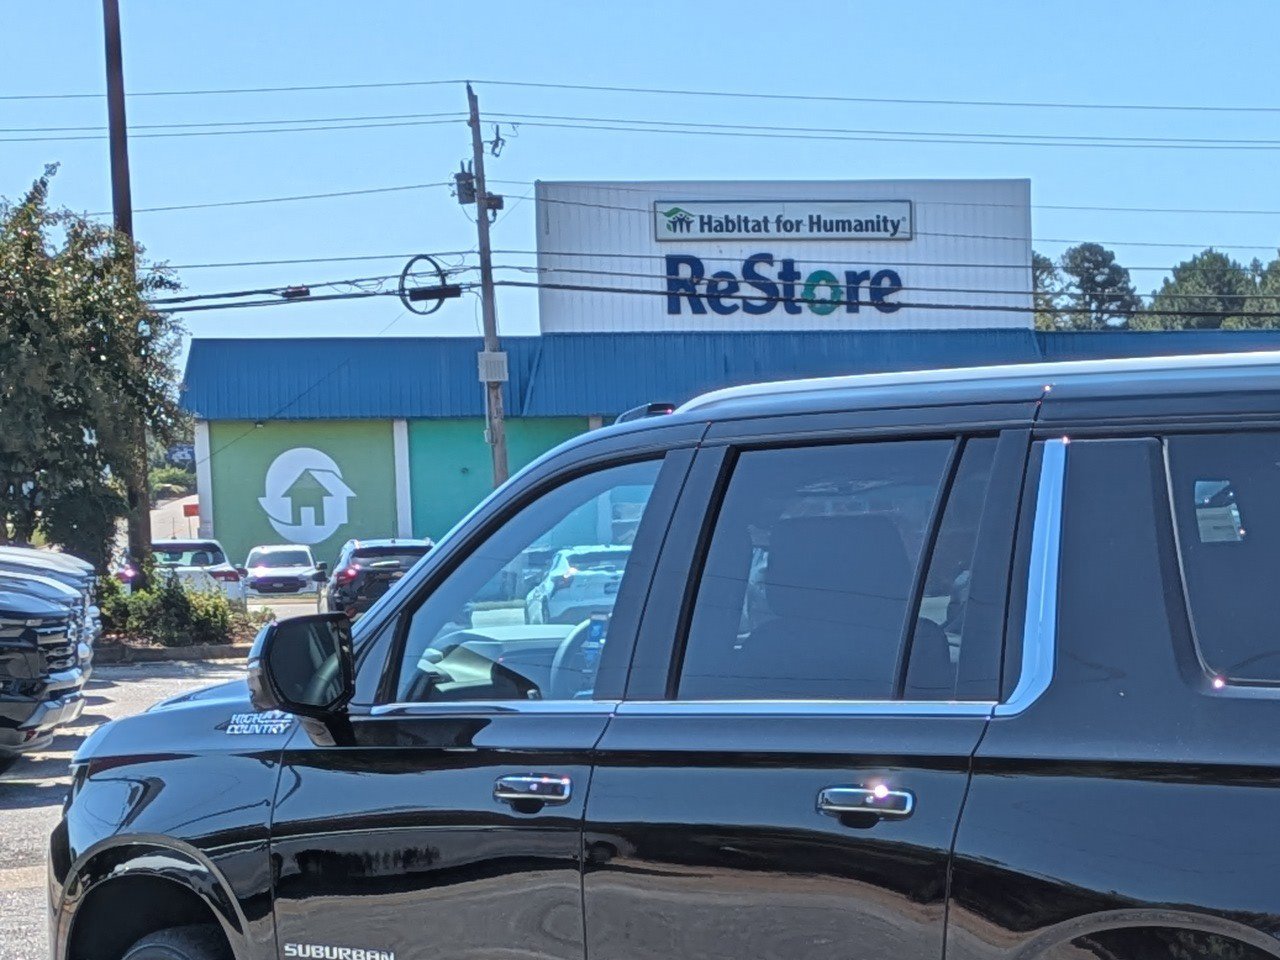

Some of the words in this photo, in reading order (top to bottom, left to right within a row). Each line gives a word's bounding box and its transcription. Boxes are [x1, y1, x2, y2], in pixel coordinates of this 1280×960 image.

[699, 214, 769, 233] Habitat
[775, 214, 804, 232] for
[808, 214, 901, 237] Humanity
[665, 253, 903, 315] ReStore
[230, 713, 262, 724] HIGH
[226, 723, 291, 735] COUNTRY
